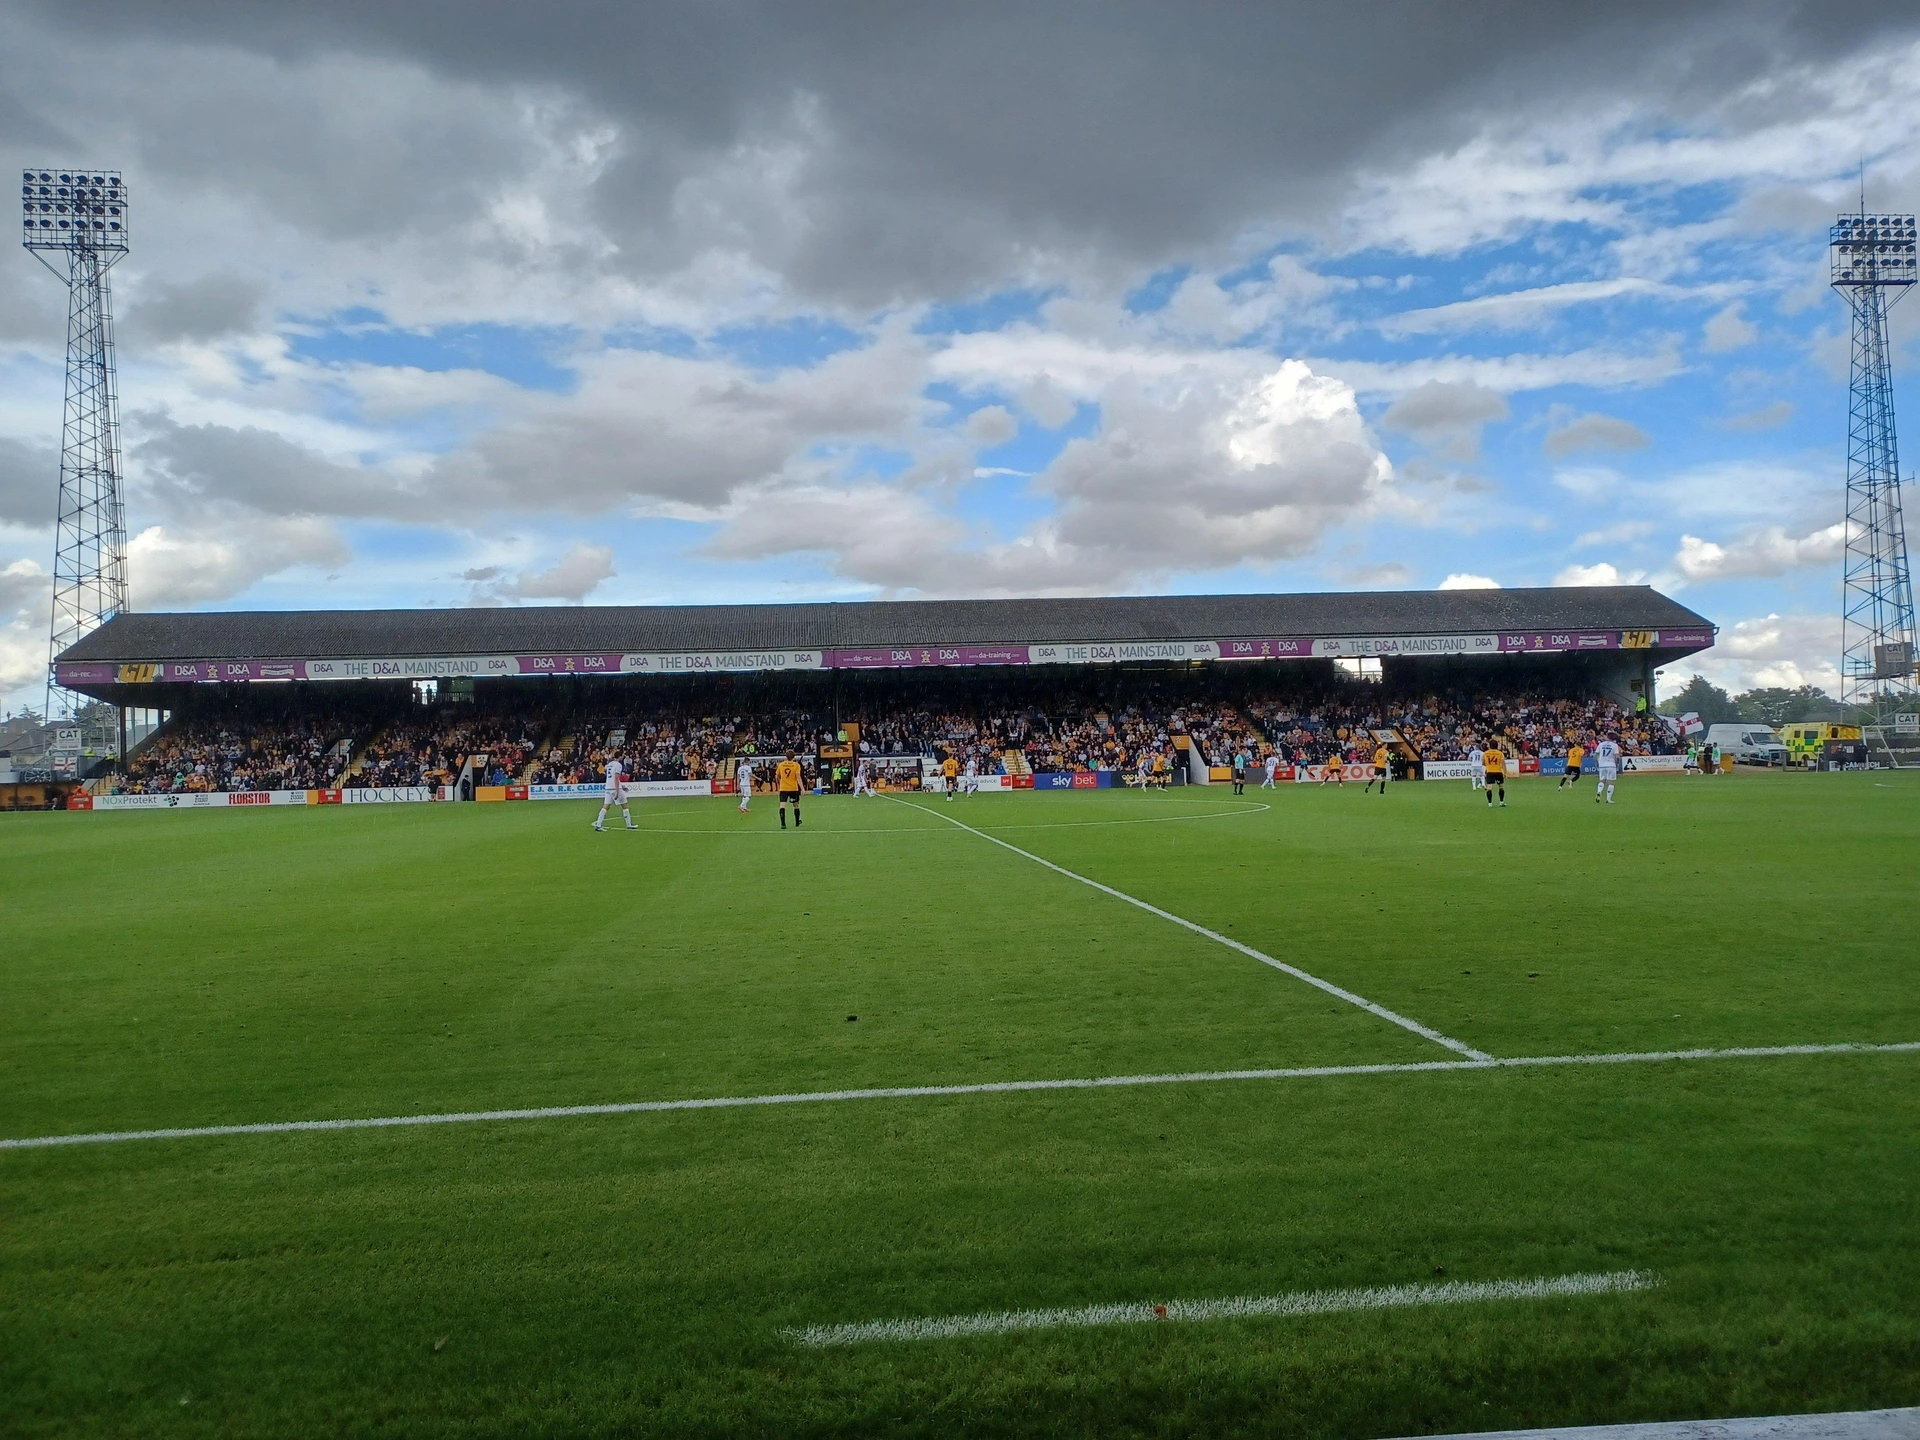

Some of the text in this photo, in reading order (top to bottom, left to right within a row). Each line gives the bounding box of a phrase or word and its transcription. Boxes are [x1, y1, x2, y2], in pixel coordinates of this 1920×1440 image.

[1349, 638, 1467, 652] THE D&A MAINSTAND
[1475, 638, 1492, 647] D&A
[1506, 636, 1526, 646] D&A
[1551, 635, 1571, 645] D&A
[1193, 644, 1211, 653] D&A
[1232, 642, 1252, 653] D&A
[1278, 641, 1298, 651] D&A
[1323, 641, 1341, 650] D&A
[891, 650, 911, 660] D&A
[939, 649, 959, 660] D&A
[1038, 648, 1056, 657] D&A
[1065, 645, 1185, 659] THE D&A MAINSTAND
[584, 656, 605, 667] D&A
[630, 657, 649, 667] D&A
[658, 654, 785, 669] THE D&A MAINSTAND
[794, 653, 812, 663] D&A
[314, 663, 333, 673] D&A
[343, 661, 479, 675] THE D&A MAINSTAND
[488, 660, 507, 669] D&A
[533, 658, 555, 669] D&A
[174, 665, 197, 676] D&A
[227, 664, 250, 675] D&A
[59, 730, 78, 739] CAT
[1601, 747, 1612, 757] 17
[1487, 755, 1498, 765] 14
[784, 768, 791, 778] 9
[1427, 769, 1472, 777] MICK GEOR
[1052, 775, 1095, 788] sky bet
[102, 795, 157, 805] NOxProtekt
[228, 792, 270, 805] FLORSTOR
